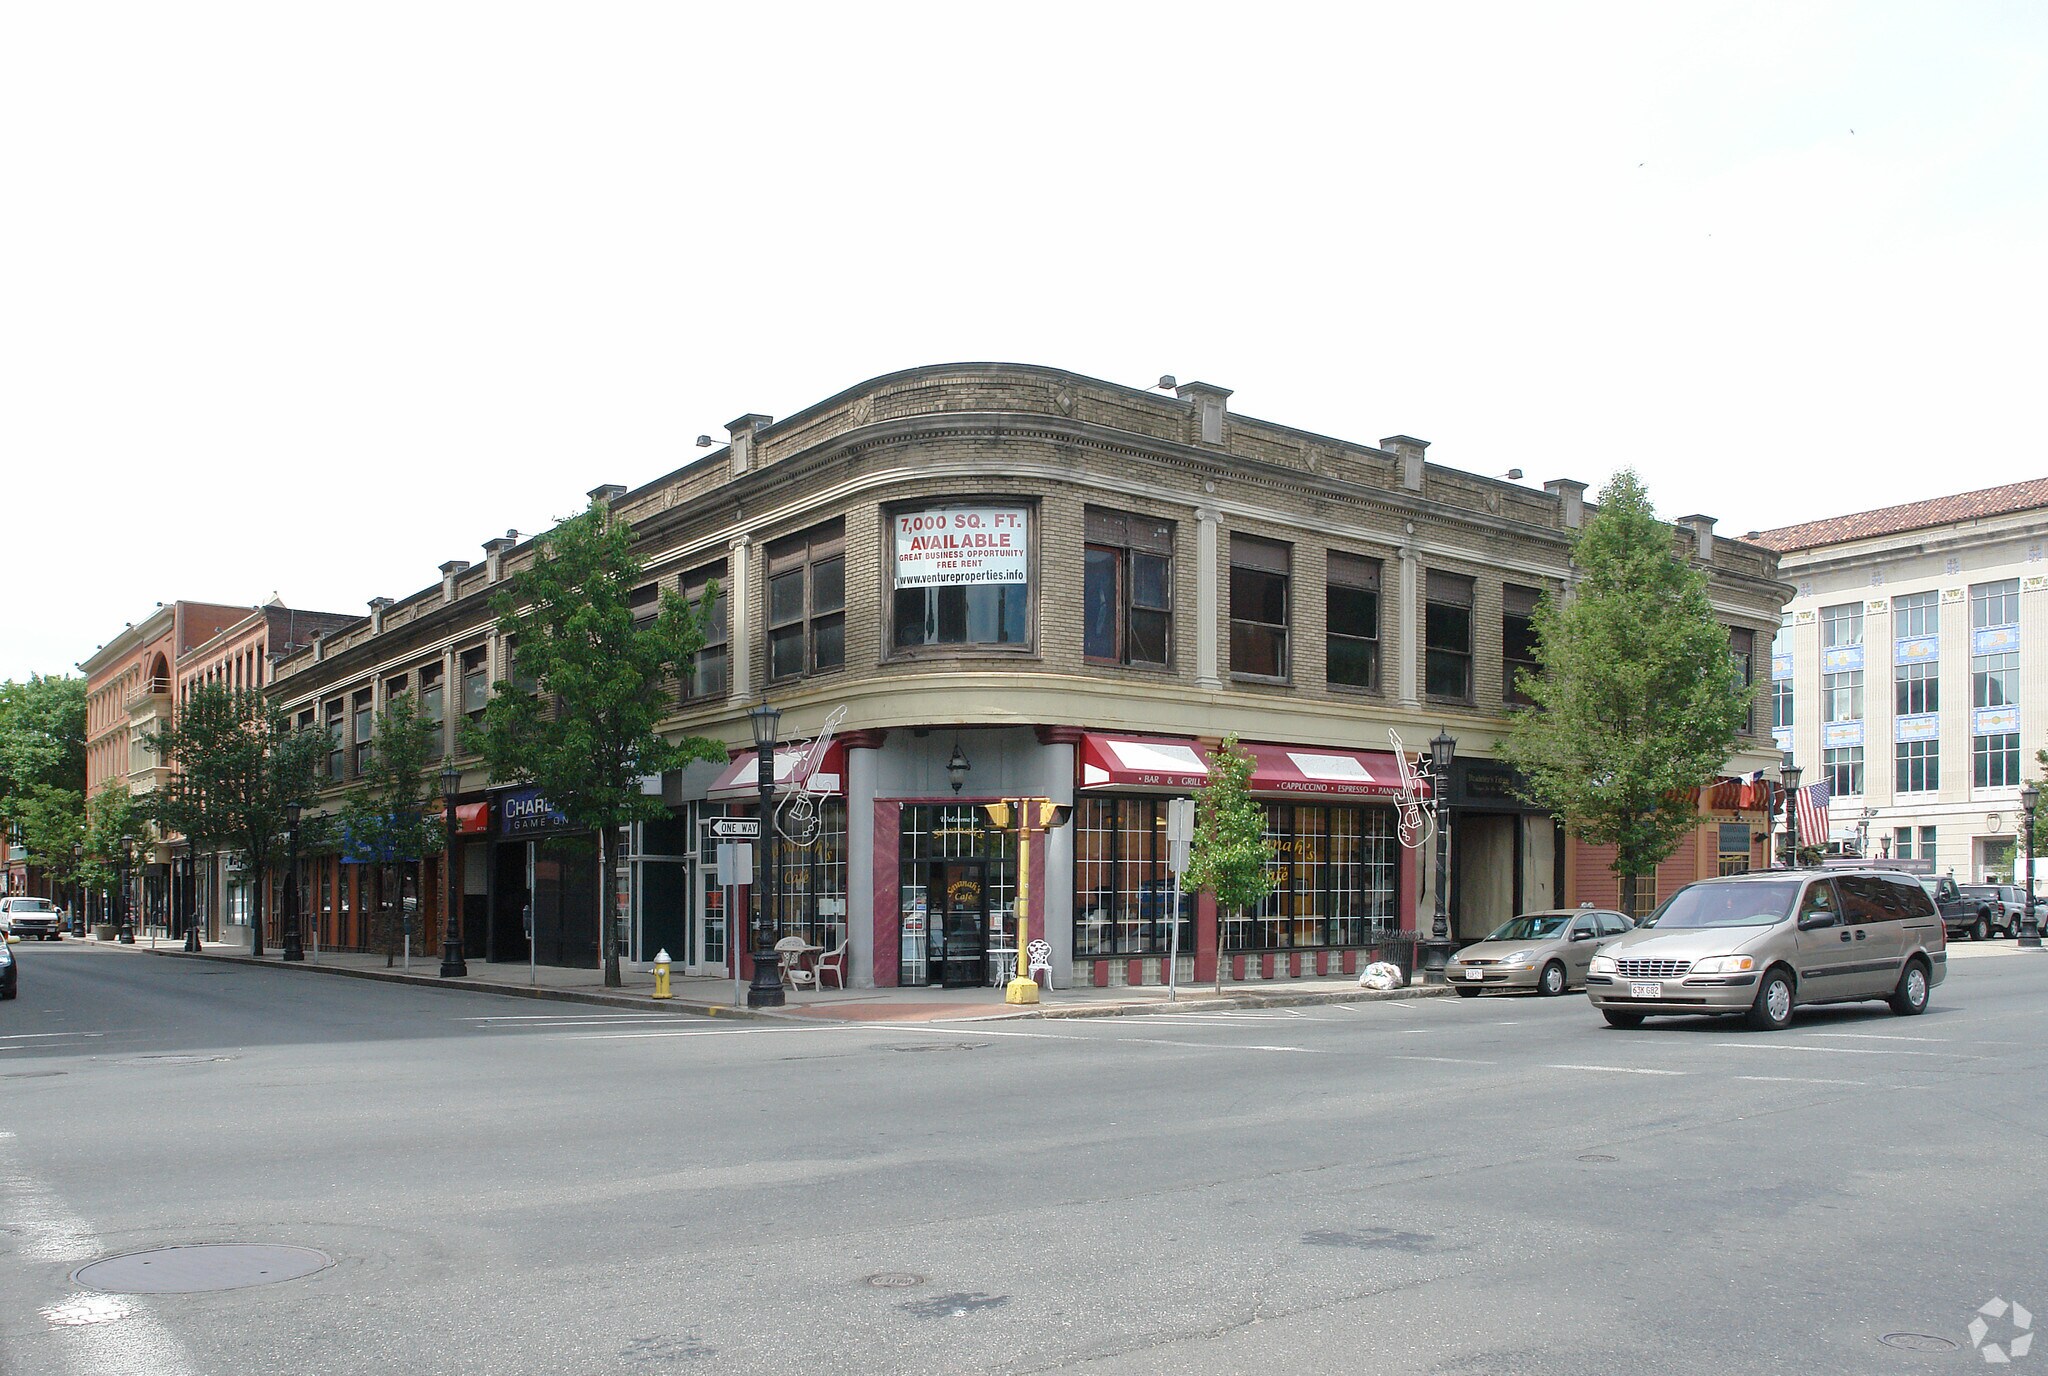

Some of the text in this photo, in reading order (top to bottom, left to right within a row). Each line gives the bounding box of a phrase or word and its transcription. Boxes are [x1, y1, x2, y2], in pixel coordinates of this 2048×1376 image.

[901, 513, 1022, 535] 7,000 SQ. FT.
[910, 533, 1011, 551] AVAILABLE
[899, 549, 1024, 562] GREAT BUSINESS OPPORTUNITY
[936, 559, 983, 569] FREE RENT
[899, 569, 1024, 585] www.ventureproperties.info
[1144, 775, 1202, 786] BAR & GRILL
[1280, 781, 1404, 796] CAPPUCCINO ESPRESSO PANNIN
[514, 816, 569, 830] GAME ON
[721, 822, 758, 833] ONE WAY
